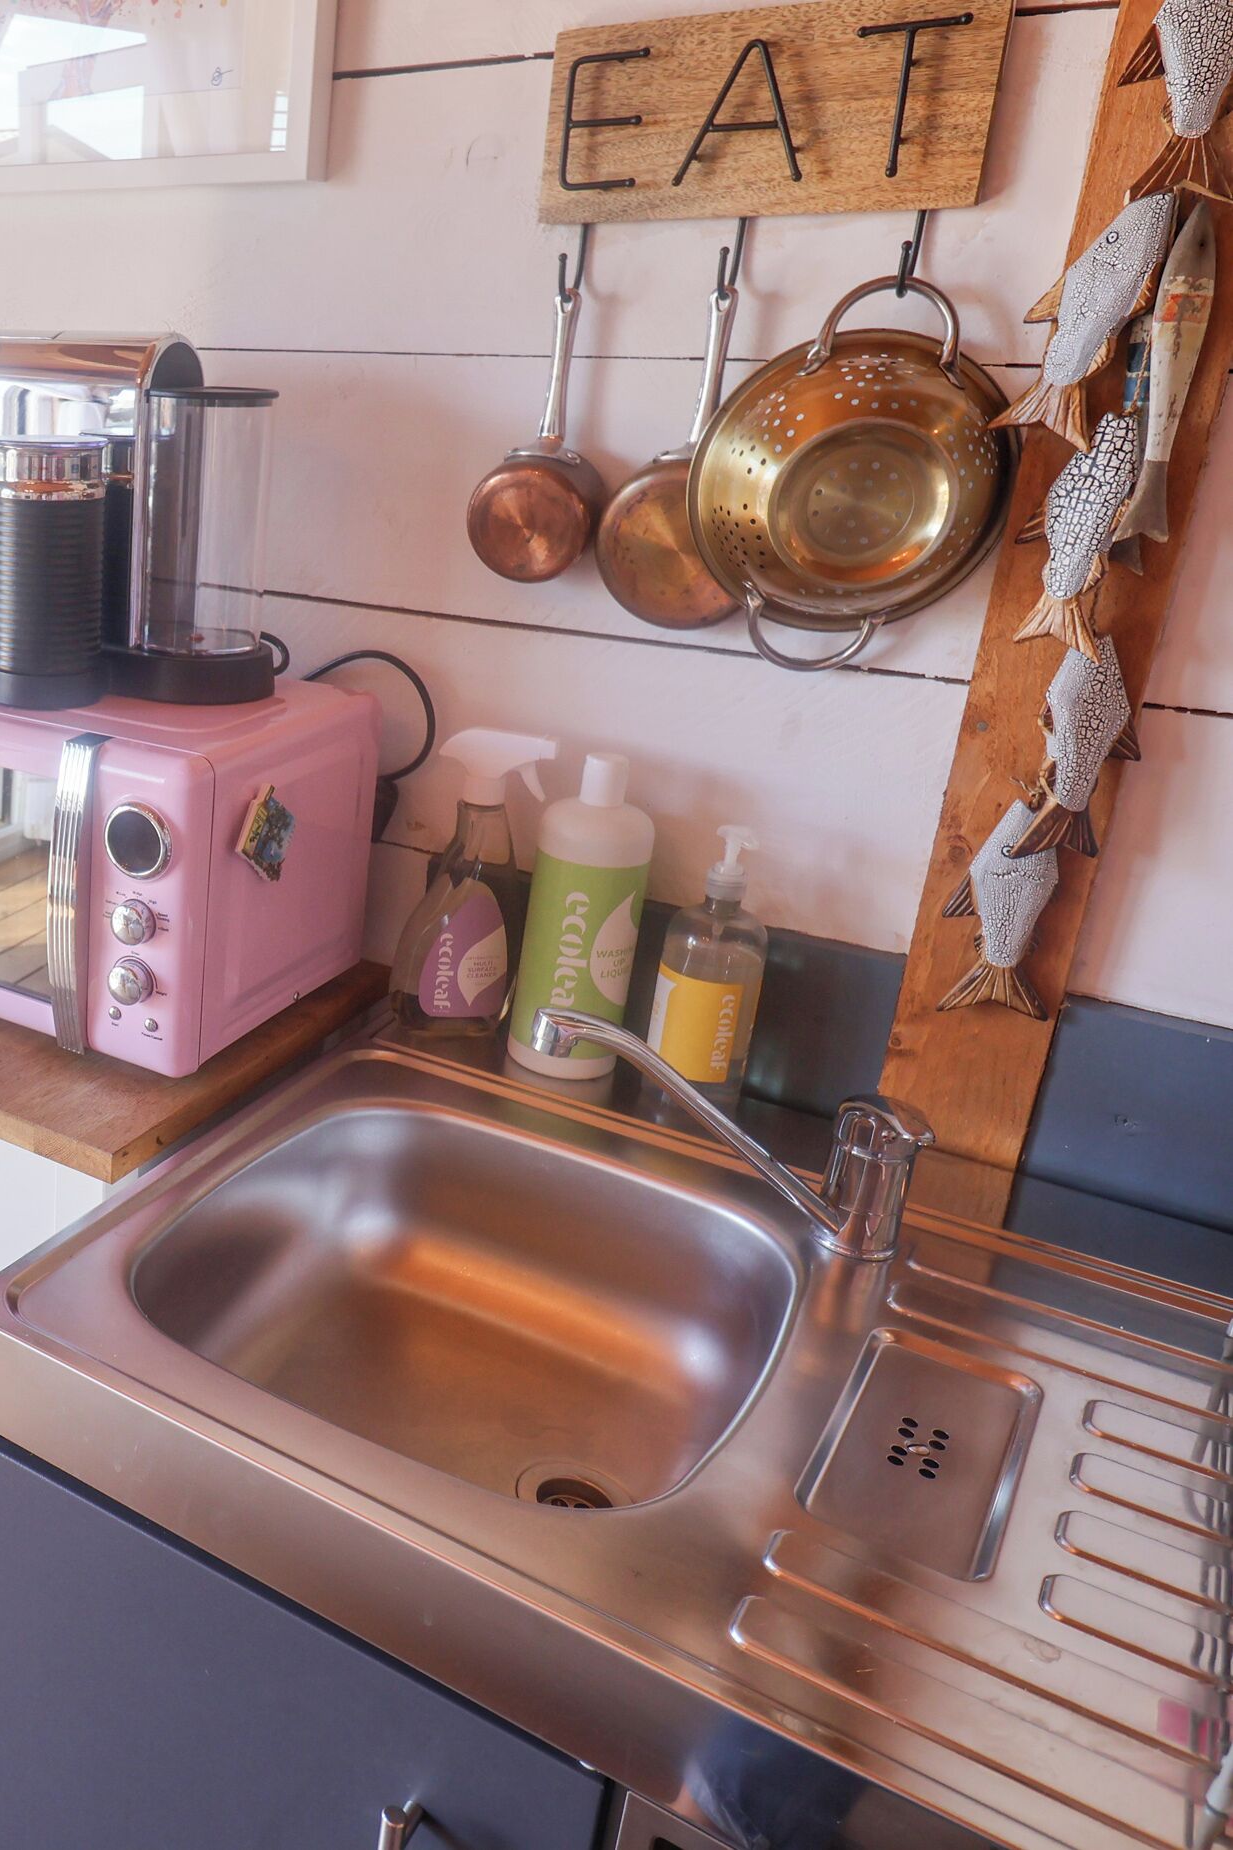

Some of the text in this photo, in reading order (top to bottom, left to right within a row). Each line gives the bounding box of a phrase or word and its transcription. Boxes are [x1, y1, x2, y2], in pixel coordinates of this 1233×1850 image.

[559, 12, 974, 191] EAT
[433, 932, 455, 1009] ecoleaf
[550, 891, 590, 1007] ecolea
[710, 994, 736, 1073] ecoleaf
